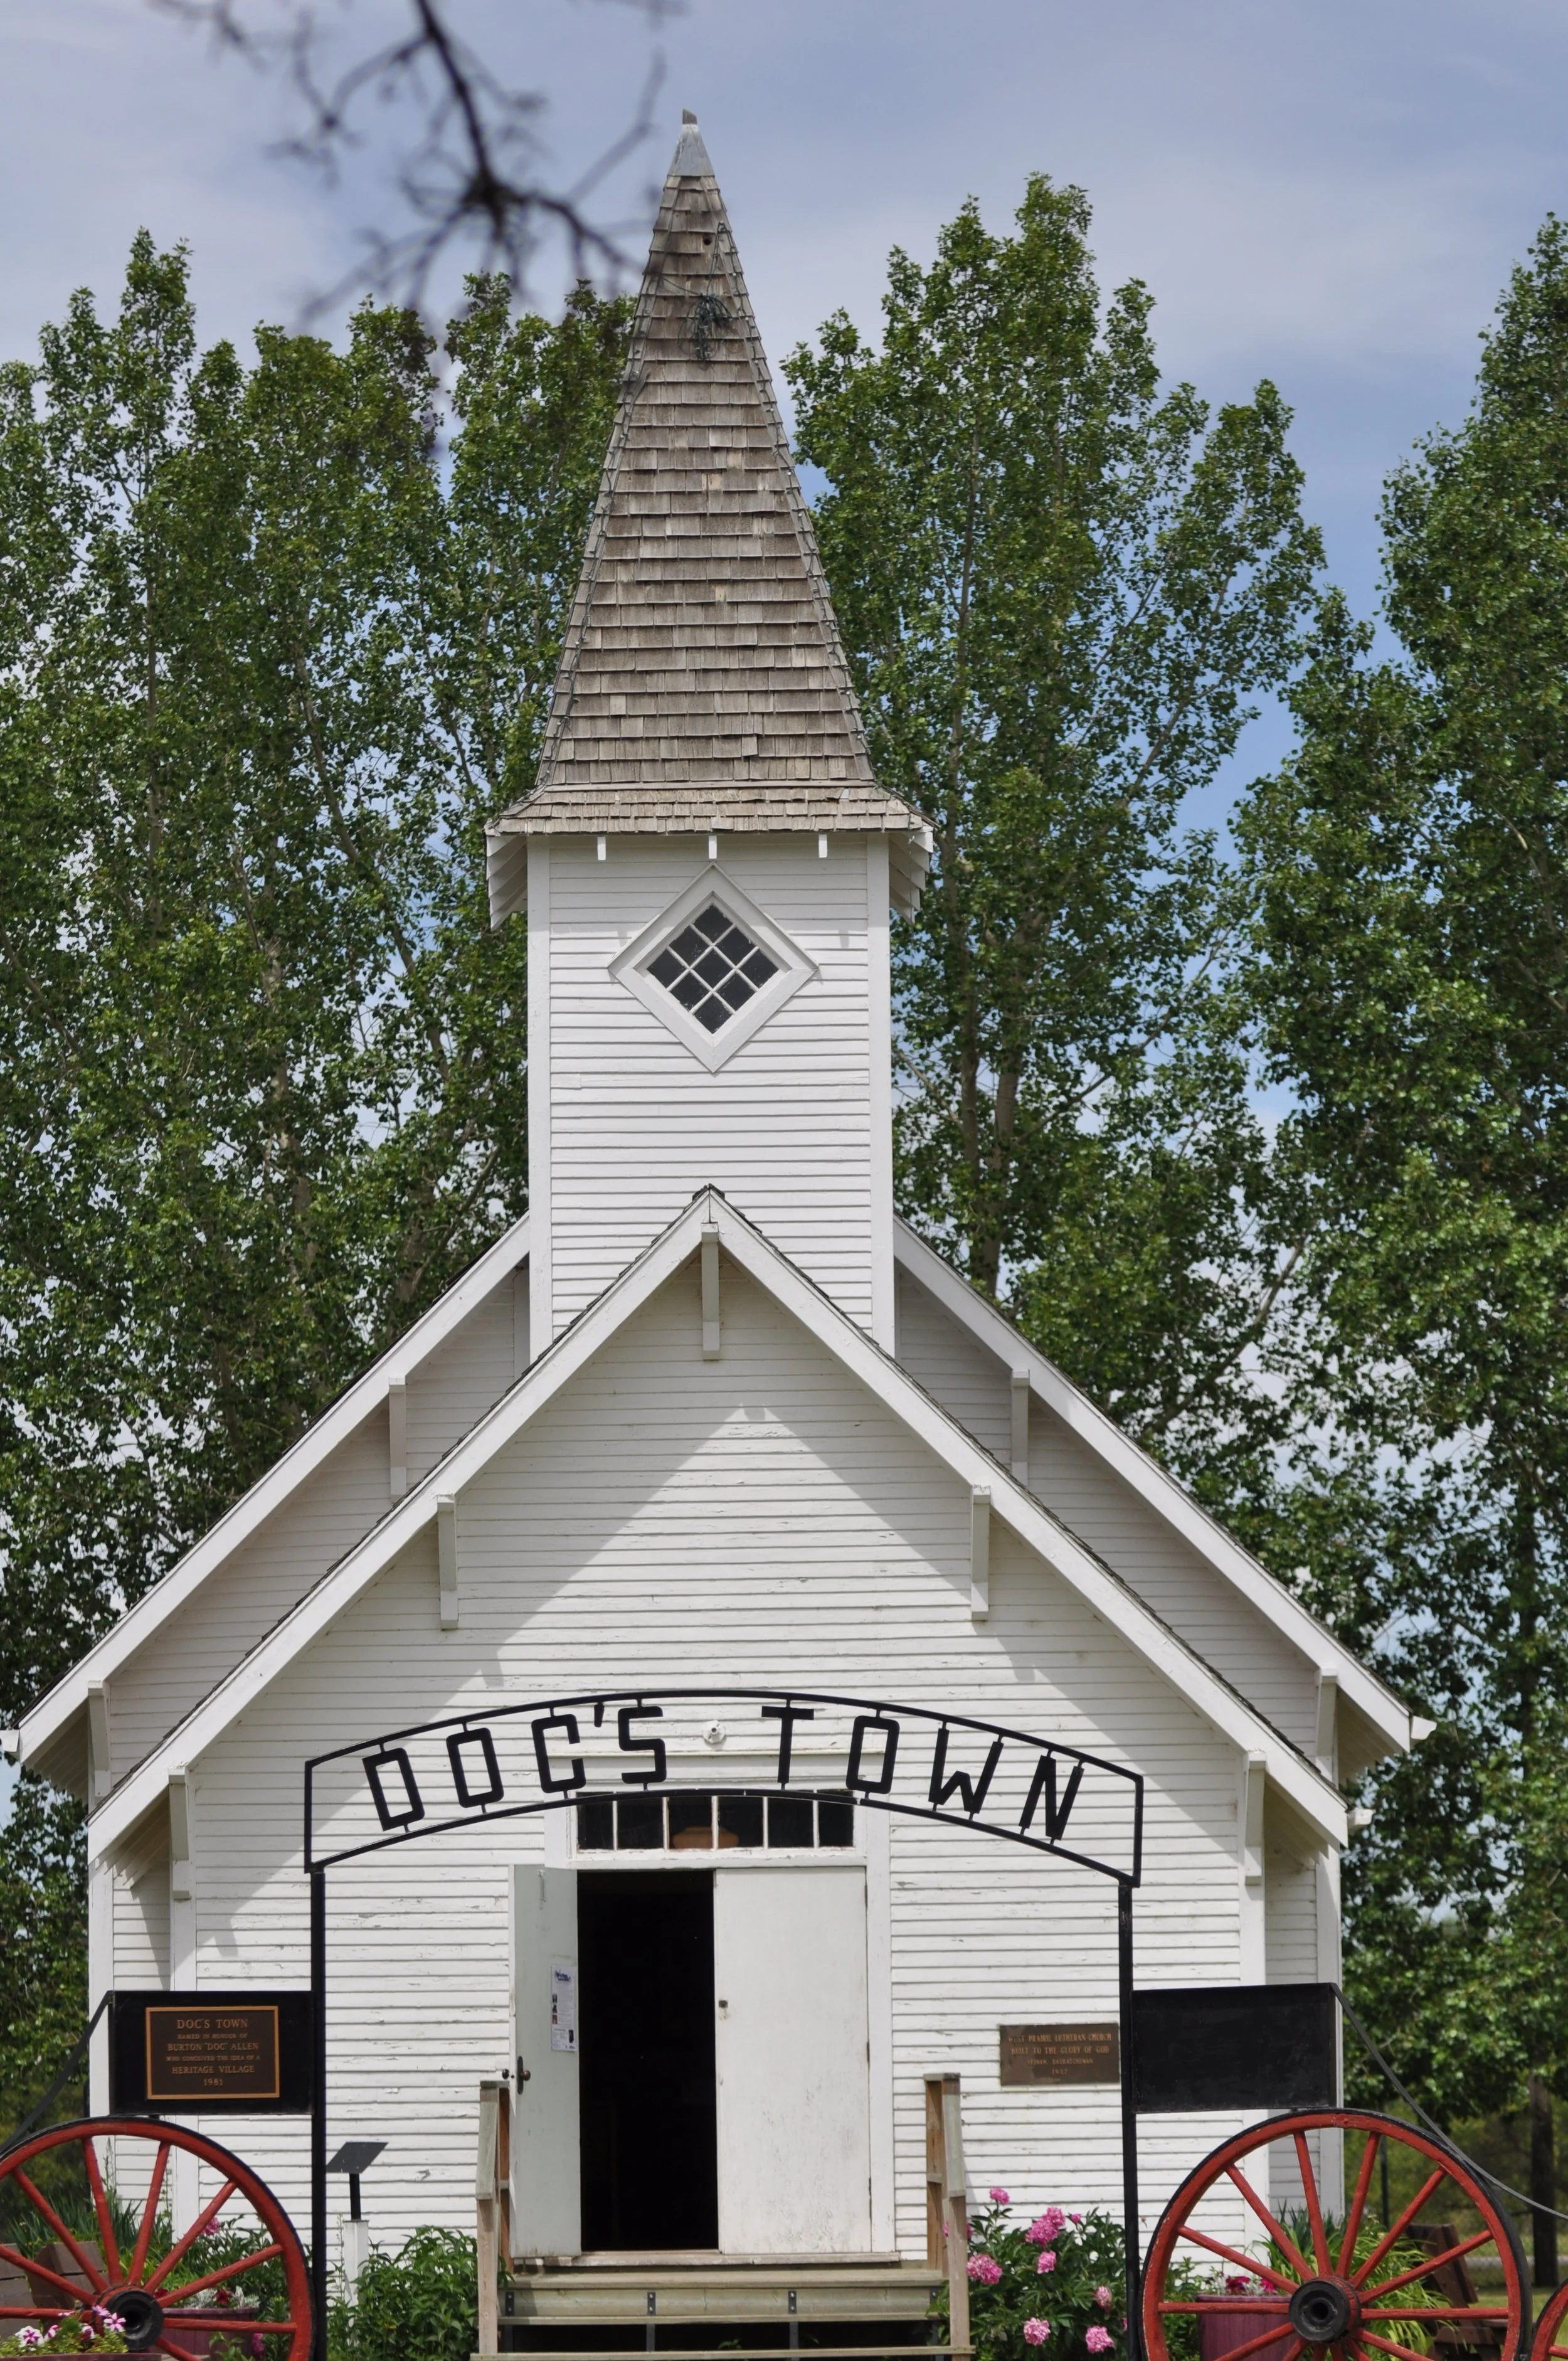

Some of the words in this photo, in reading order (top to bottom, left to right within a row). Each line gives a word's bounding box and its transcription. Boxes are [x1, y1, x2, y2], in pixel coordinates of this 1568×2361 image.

[362, 1701, 667, 1831] DOC'S
[761, 1707, 1084, 1841] TOWN
[176, 2019, 210, 2029] DOC'S
[216, 2019, 248, 2029] TOWN
[1055, 2034, 1086, 2042] LUTHERAN
[1089, 2033, 1111, 2041] CHURCH
[1061, 2046, 1080, 2054] GLORY
[1084, 2045, 1092, 2054] OF
[1096, 2045, 1109, 2054] GOD
[203, 2078, 223, 2086] 1981
